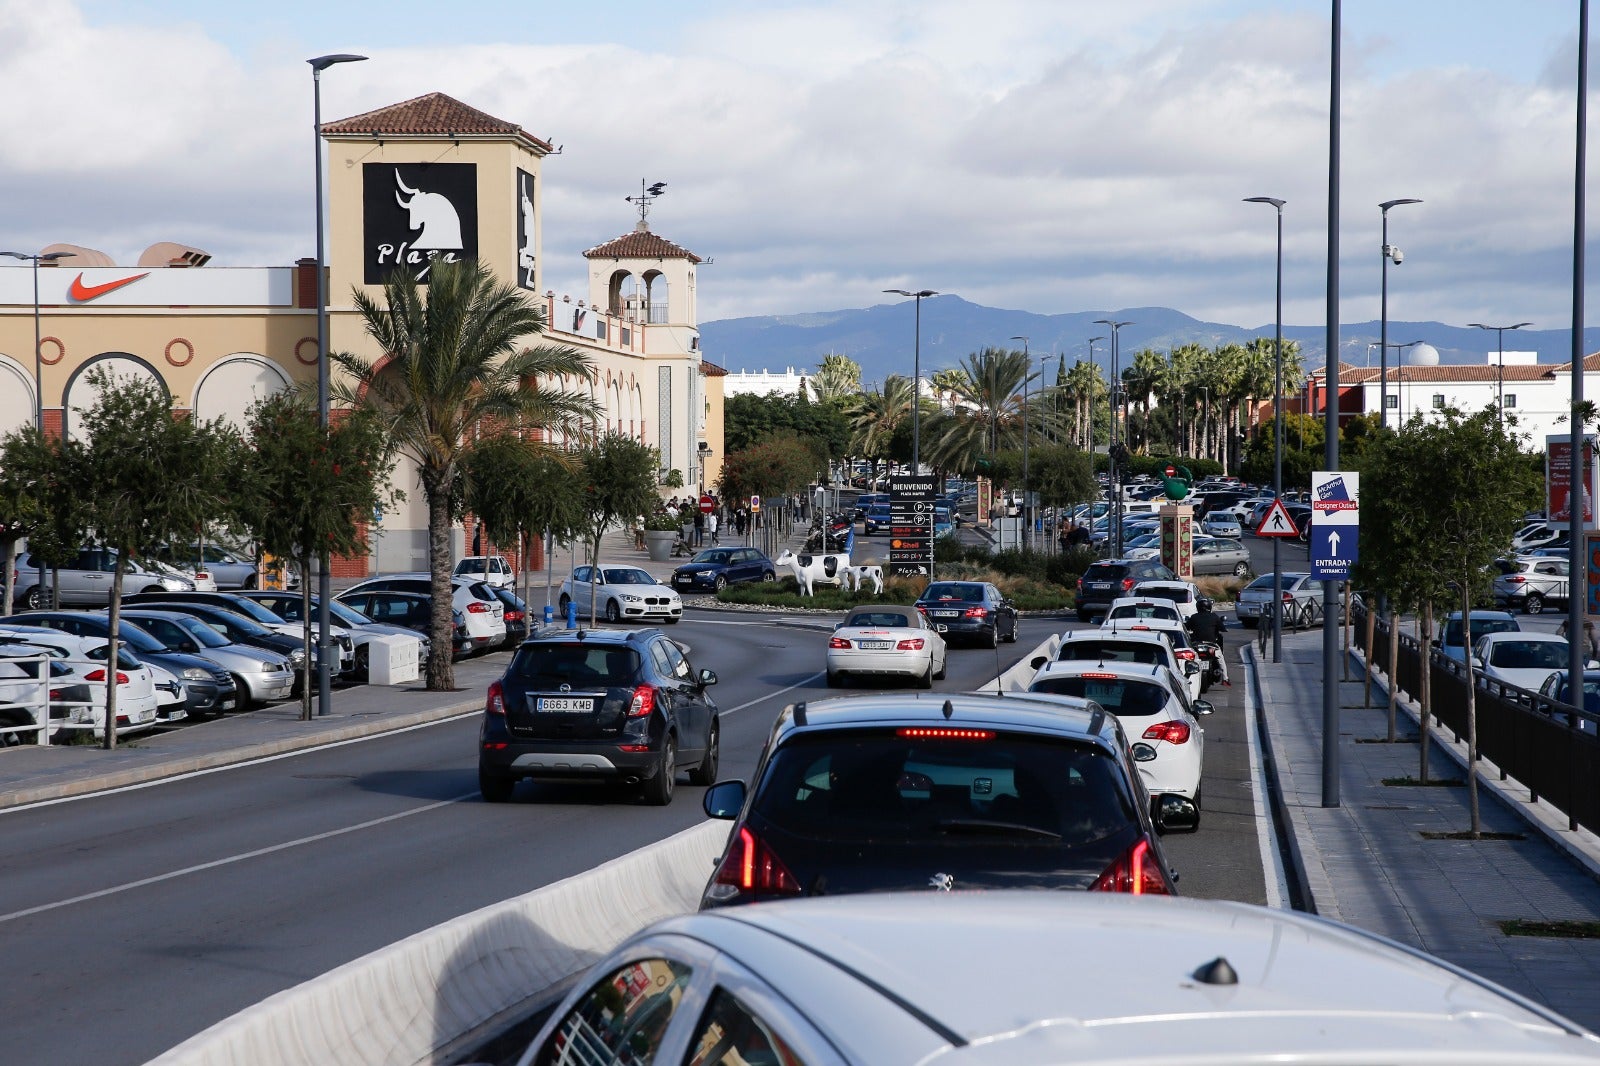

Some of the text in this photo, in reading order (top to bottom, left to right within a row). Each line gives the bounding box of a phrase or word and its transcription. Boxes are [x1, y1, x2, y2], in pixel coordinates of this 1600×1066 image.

[892, 483, 932, 491] BIENVENIDO
[1320, 490, 1333, 500] Glen
[1314, 502, 1338, 510] Designer
[1315, 559, 1347, 567] ENTRADA
[543, 699, 568, 710] 6663
